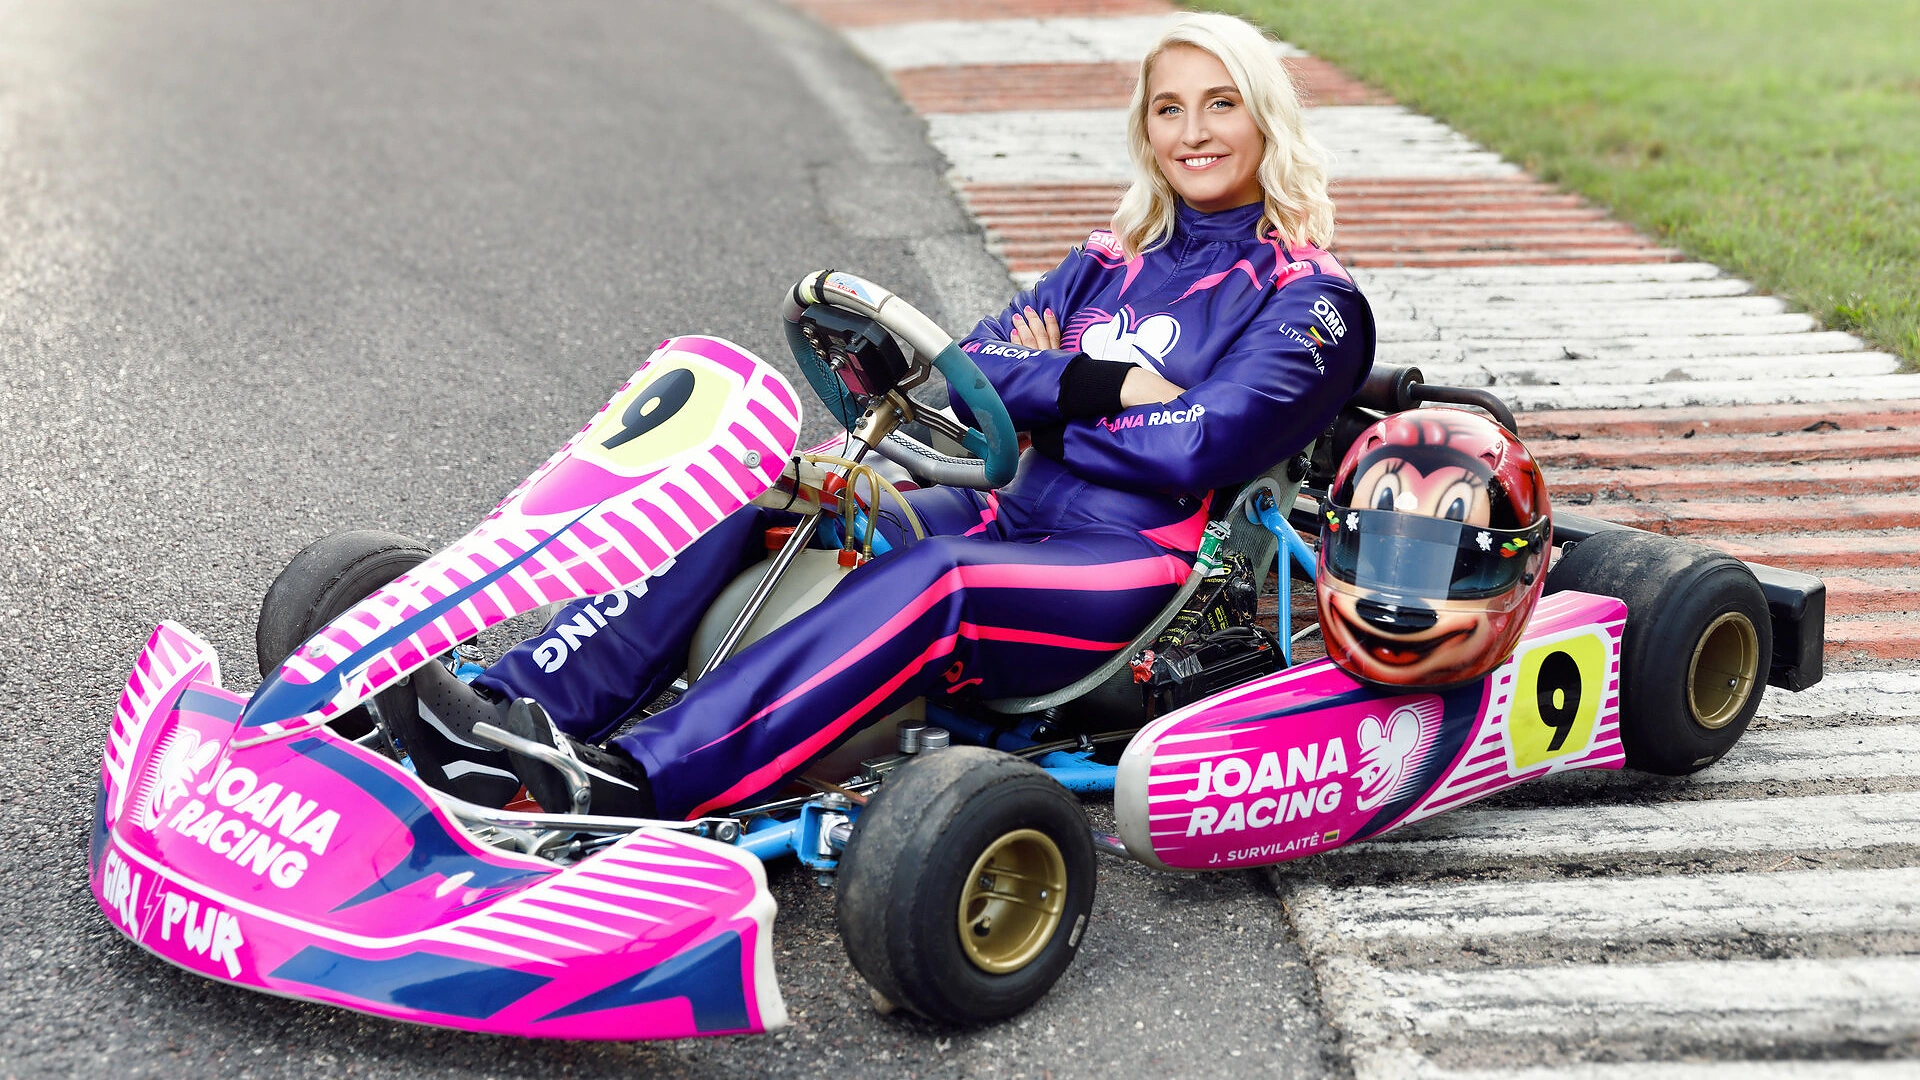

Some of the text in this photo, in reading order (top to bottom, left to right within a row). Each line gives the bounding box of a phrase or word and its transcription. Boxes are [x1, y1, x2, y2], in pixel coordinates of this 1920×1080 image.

[1088, 232, 1124, 253] OMP
[1278, 322, 1326, 375] LITHUANIA
[1313, 300, 1345, 338] OMP
[600, 368, 696, 450] 9
[1535, 650, 1583, 752] 9
[1184, 736, 1349, 803] JOANA
[196, 757, 341, 857] JOANA
[1185, 781, 1343, 838] RACING
[167, 798, 309, 890] RACING
[1208, 831, 1320, 865] J. SURVILAITĖ
[102, 849, 245, 980] GIRL PWR
